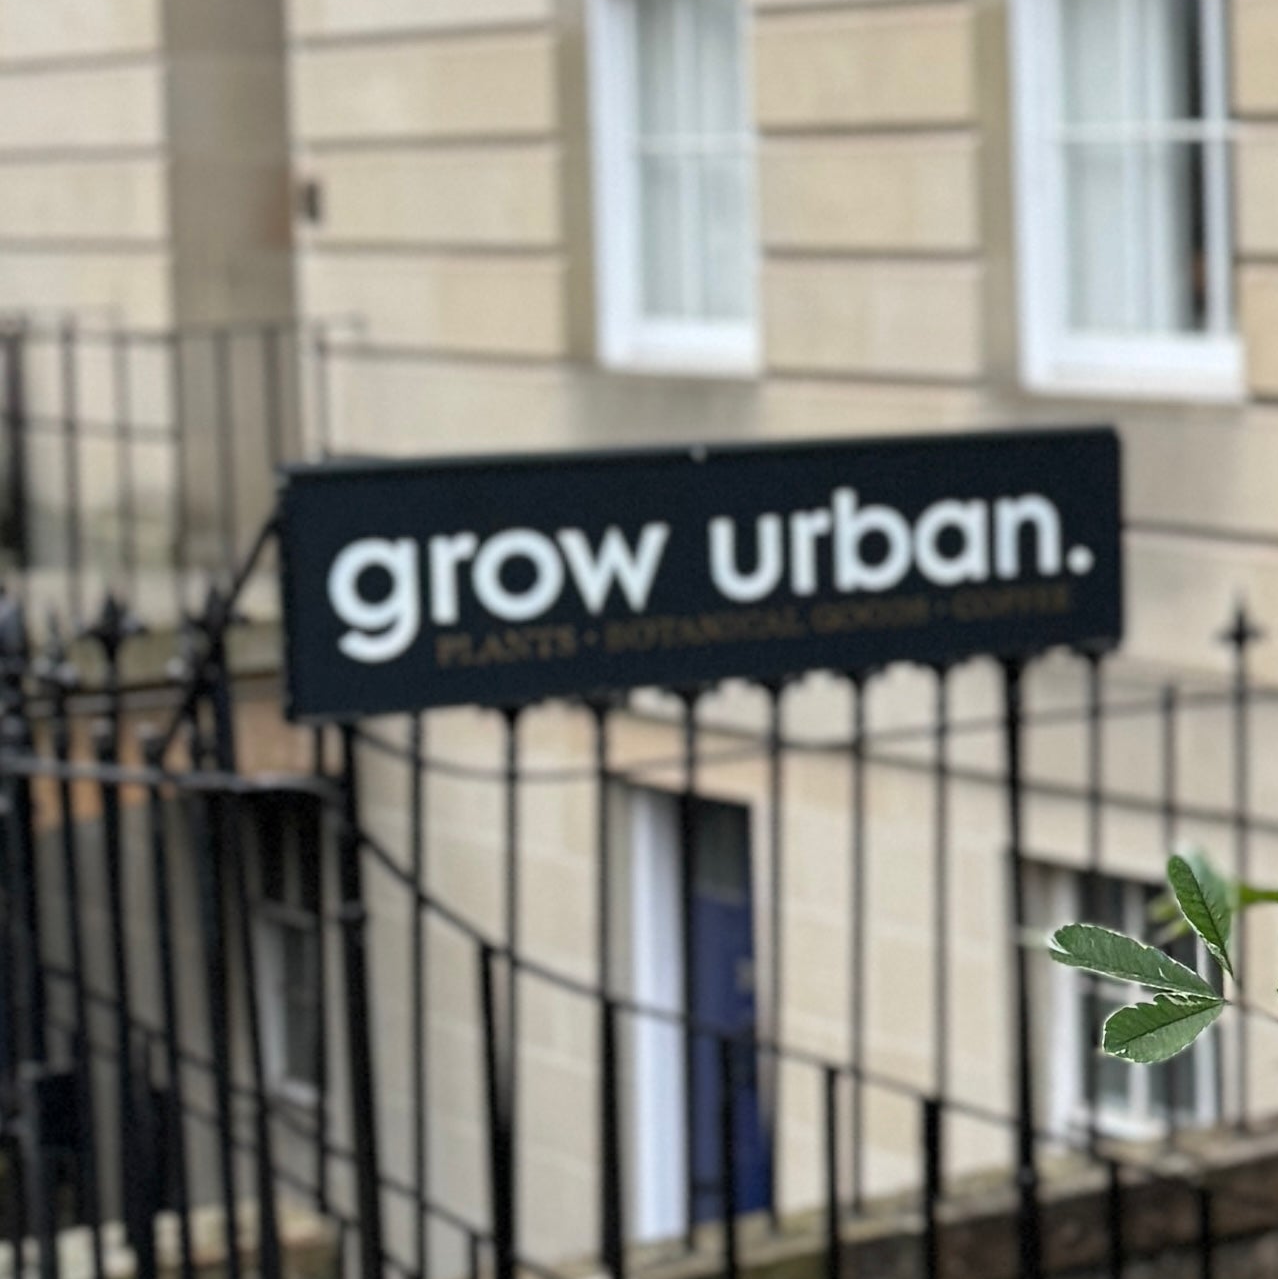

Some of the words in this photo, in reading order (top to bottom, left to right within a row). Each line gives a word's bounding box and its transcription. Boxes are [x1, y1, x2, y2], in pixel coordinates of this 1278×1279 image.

[327, 522, 670, 663] grow
[708, 487, 1093, 604] urban.
[435, 625, 578, 669] PLANTS
